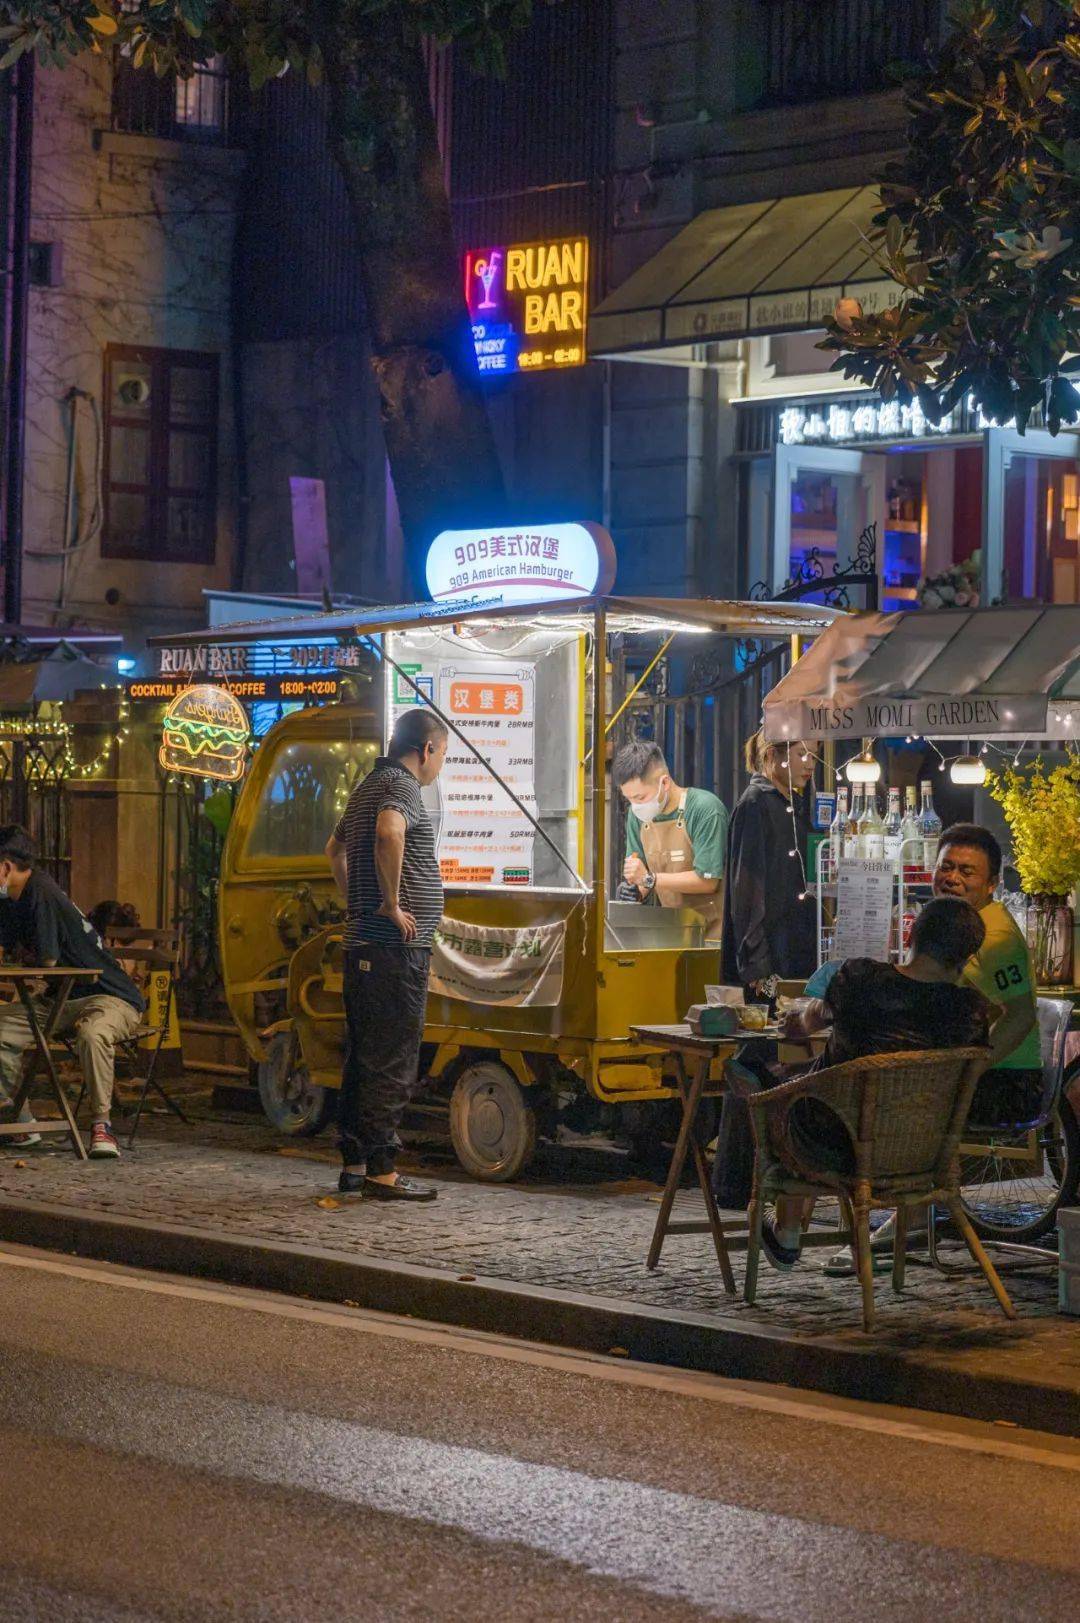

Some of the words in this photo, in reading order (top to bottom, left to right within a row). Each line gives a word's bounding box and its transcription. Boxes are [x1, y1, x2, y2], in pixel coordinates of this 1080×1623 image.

[506, 242, 582, 291] RUAN
[525, 291, 583, 334] BAR
[455, 534, 559, 566] 909美式汉堡
[450, 571, 469, 588] 909
[471, 563, 517, 582] American
[519, 562, 574, 582] Hamburger
[160, 648, 207, 671] RUAN
[209, 648, 246, 671] BAR
[130, 684, 175, 697] COCKTAIL
[229, 682, 266, 696] COFFEE
[454, 688, 519, 710] 汉堡类
[810, 707, 854, 731] MISS
[866, 704, 913, 728] MOMI
[926, 700, 1000, 726] GARDEN
[994, 964, 1023, 991] 03
